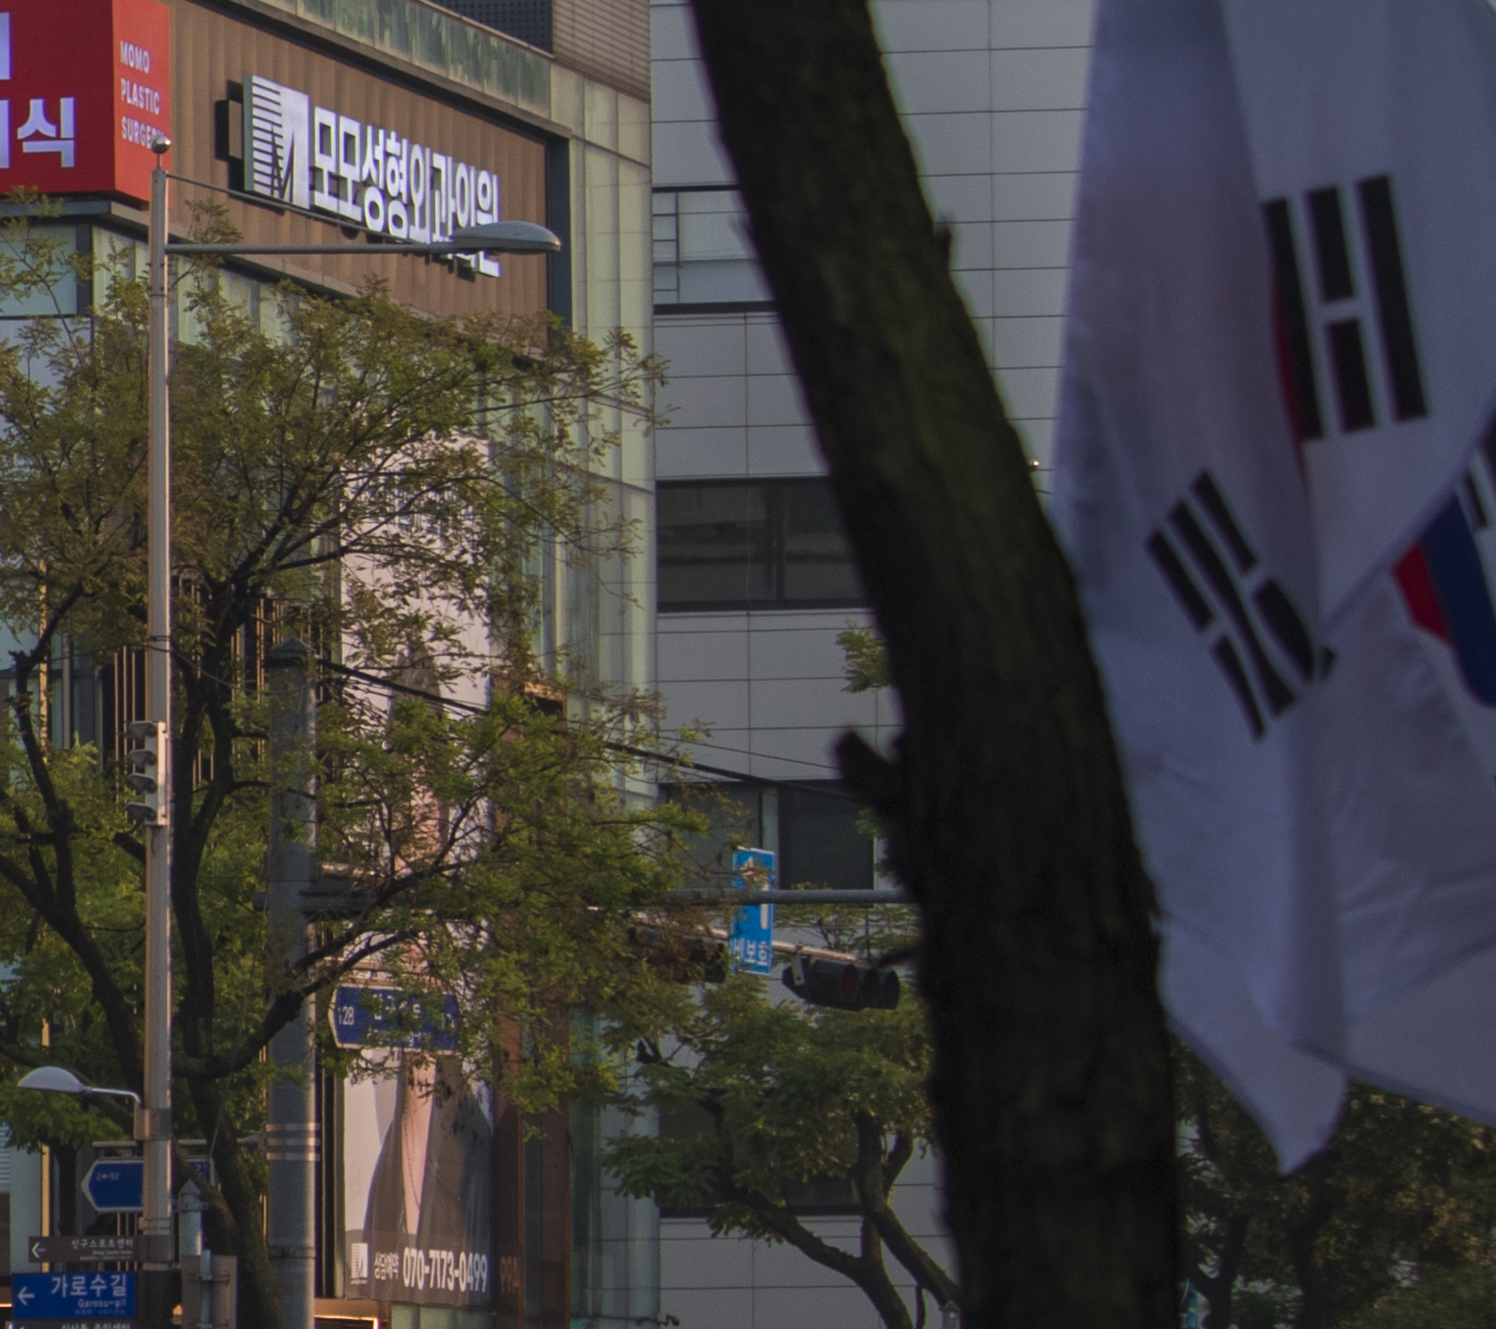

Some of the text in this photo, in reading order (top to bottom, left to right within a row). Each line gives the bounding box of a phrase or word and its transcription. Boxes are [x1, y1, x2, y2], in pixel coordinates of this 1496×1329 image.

[119, 40, 151, 74] MOMO
[120, 77, 161, 116] PLASTIC
[312, 104, 502, 279] 모모성형외과의원
[50, 1274, 128, 1298] 가로수길
[402, 1245, 489, 1294] 070-7173-0499
